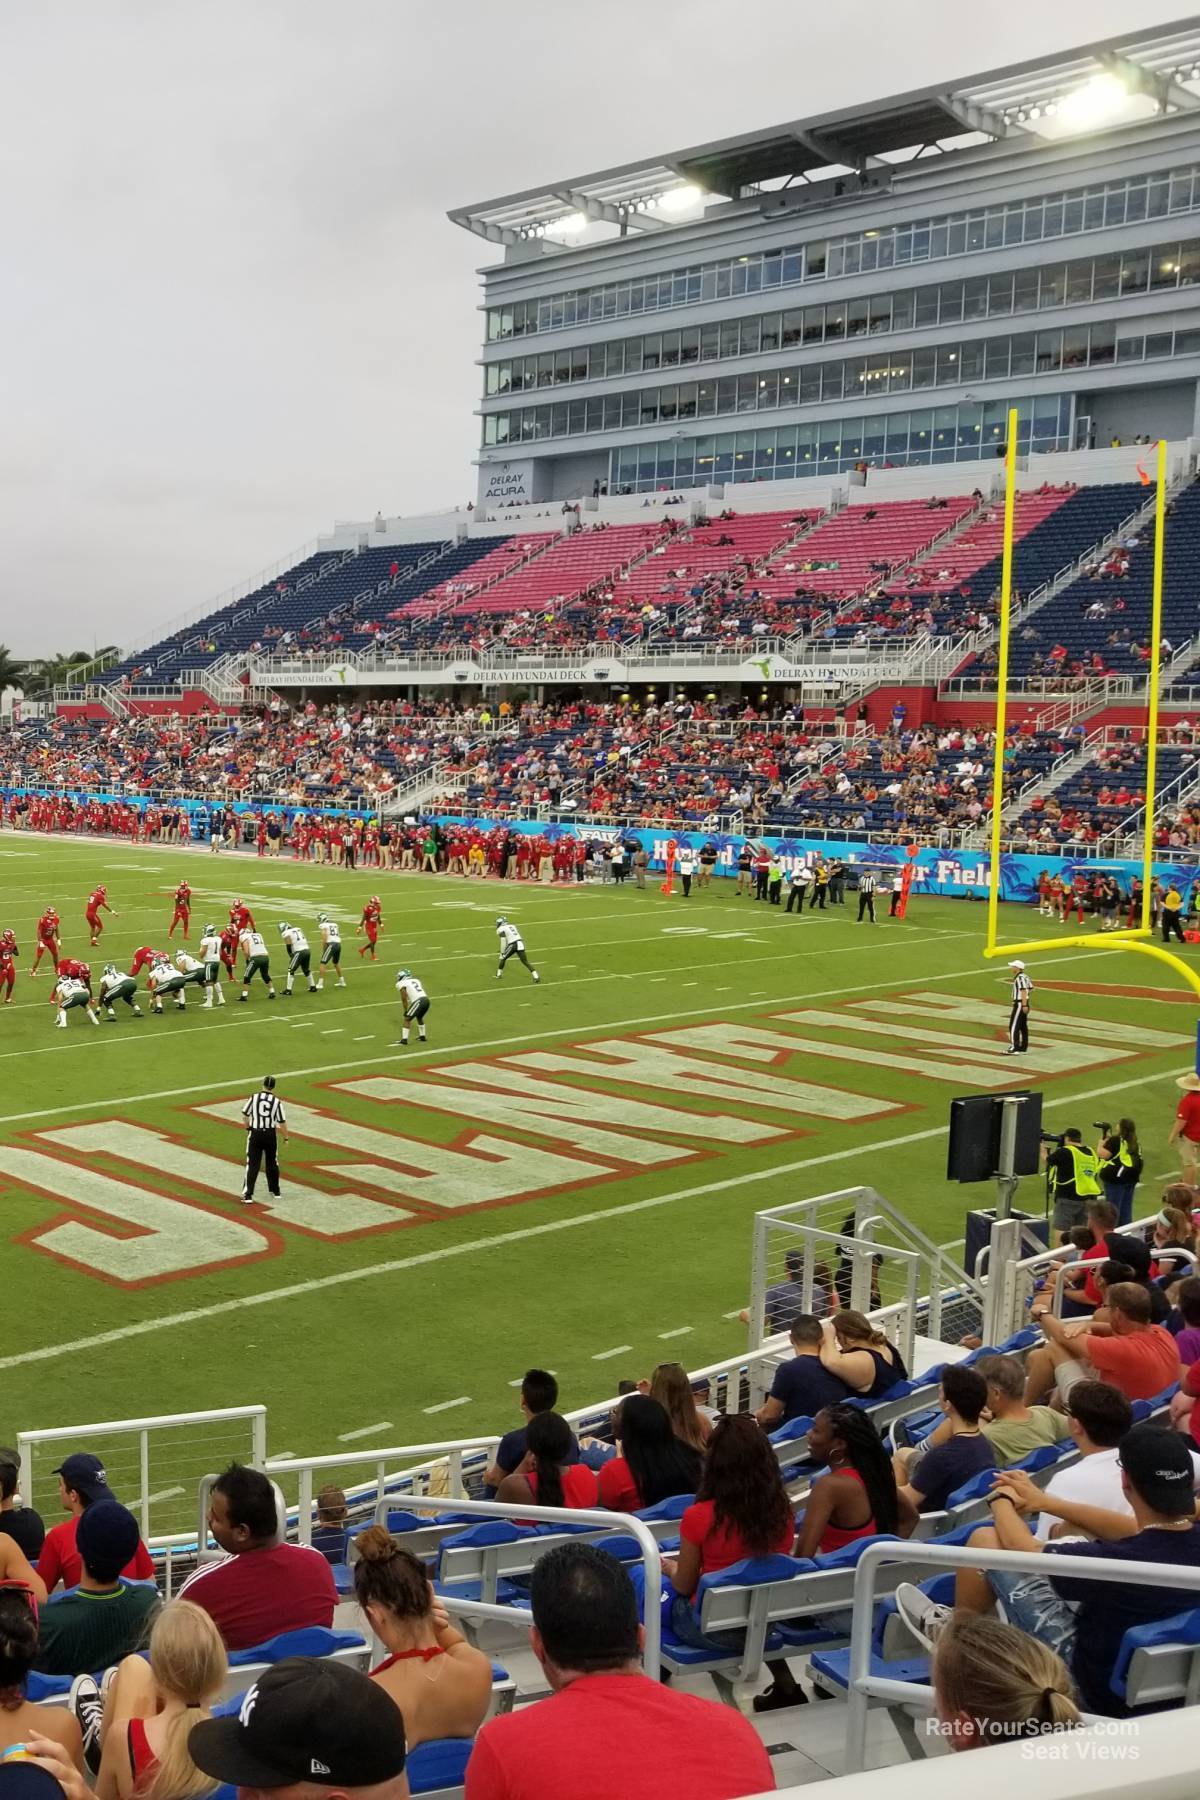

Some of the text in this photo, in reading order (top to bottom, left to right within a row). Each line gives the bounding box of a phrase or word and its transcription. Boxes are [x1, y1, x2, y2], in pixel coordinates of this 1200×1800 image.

[490, 474, 523, 485] DELRAY
[485, 486, 525, 497] ACURA
[474, 671, 511, 681] DELRAY
[511, 671, 559, 681] HYUNDAI
[560, 670, 587, 680] DECK
[774, 669, 816, 678] DELRAY
[258, 675, 333, 684] DELRAY HYUNDAI DECK
[582, 830, 618, 842] FAU
[63, 980, 80, 989] 35
[412, 981, 419, 990] 2
[258, 1099, 272, 1117] C
